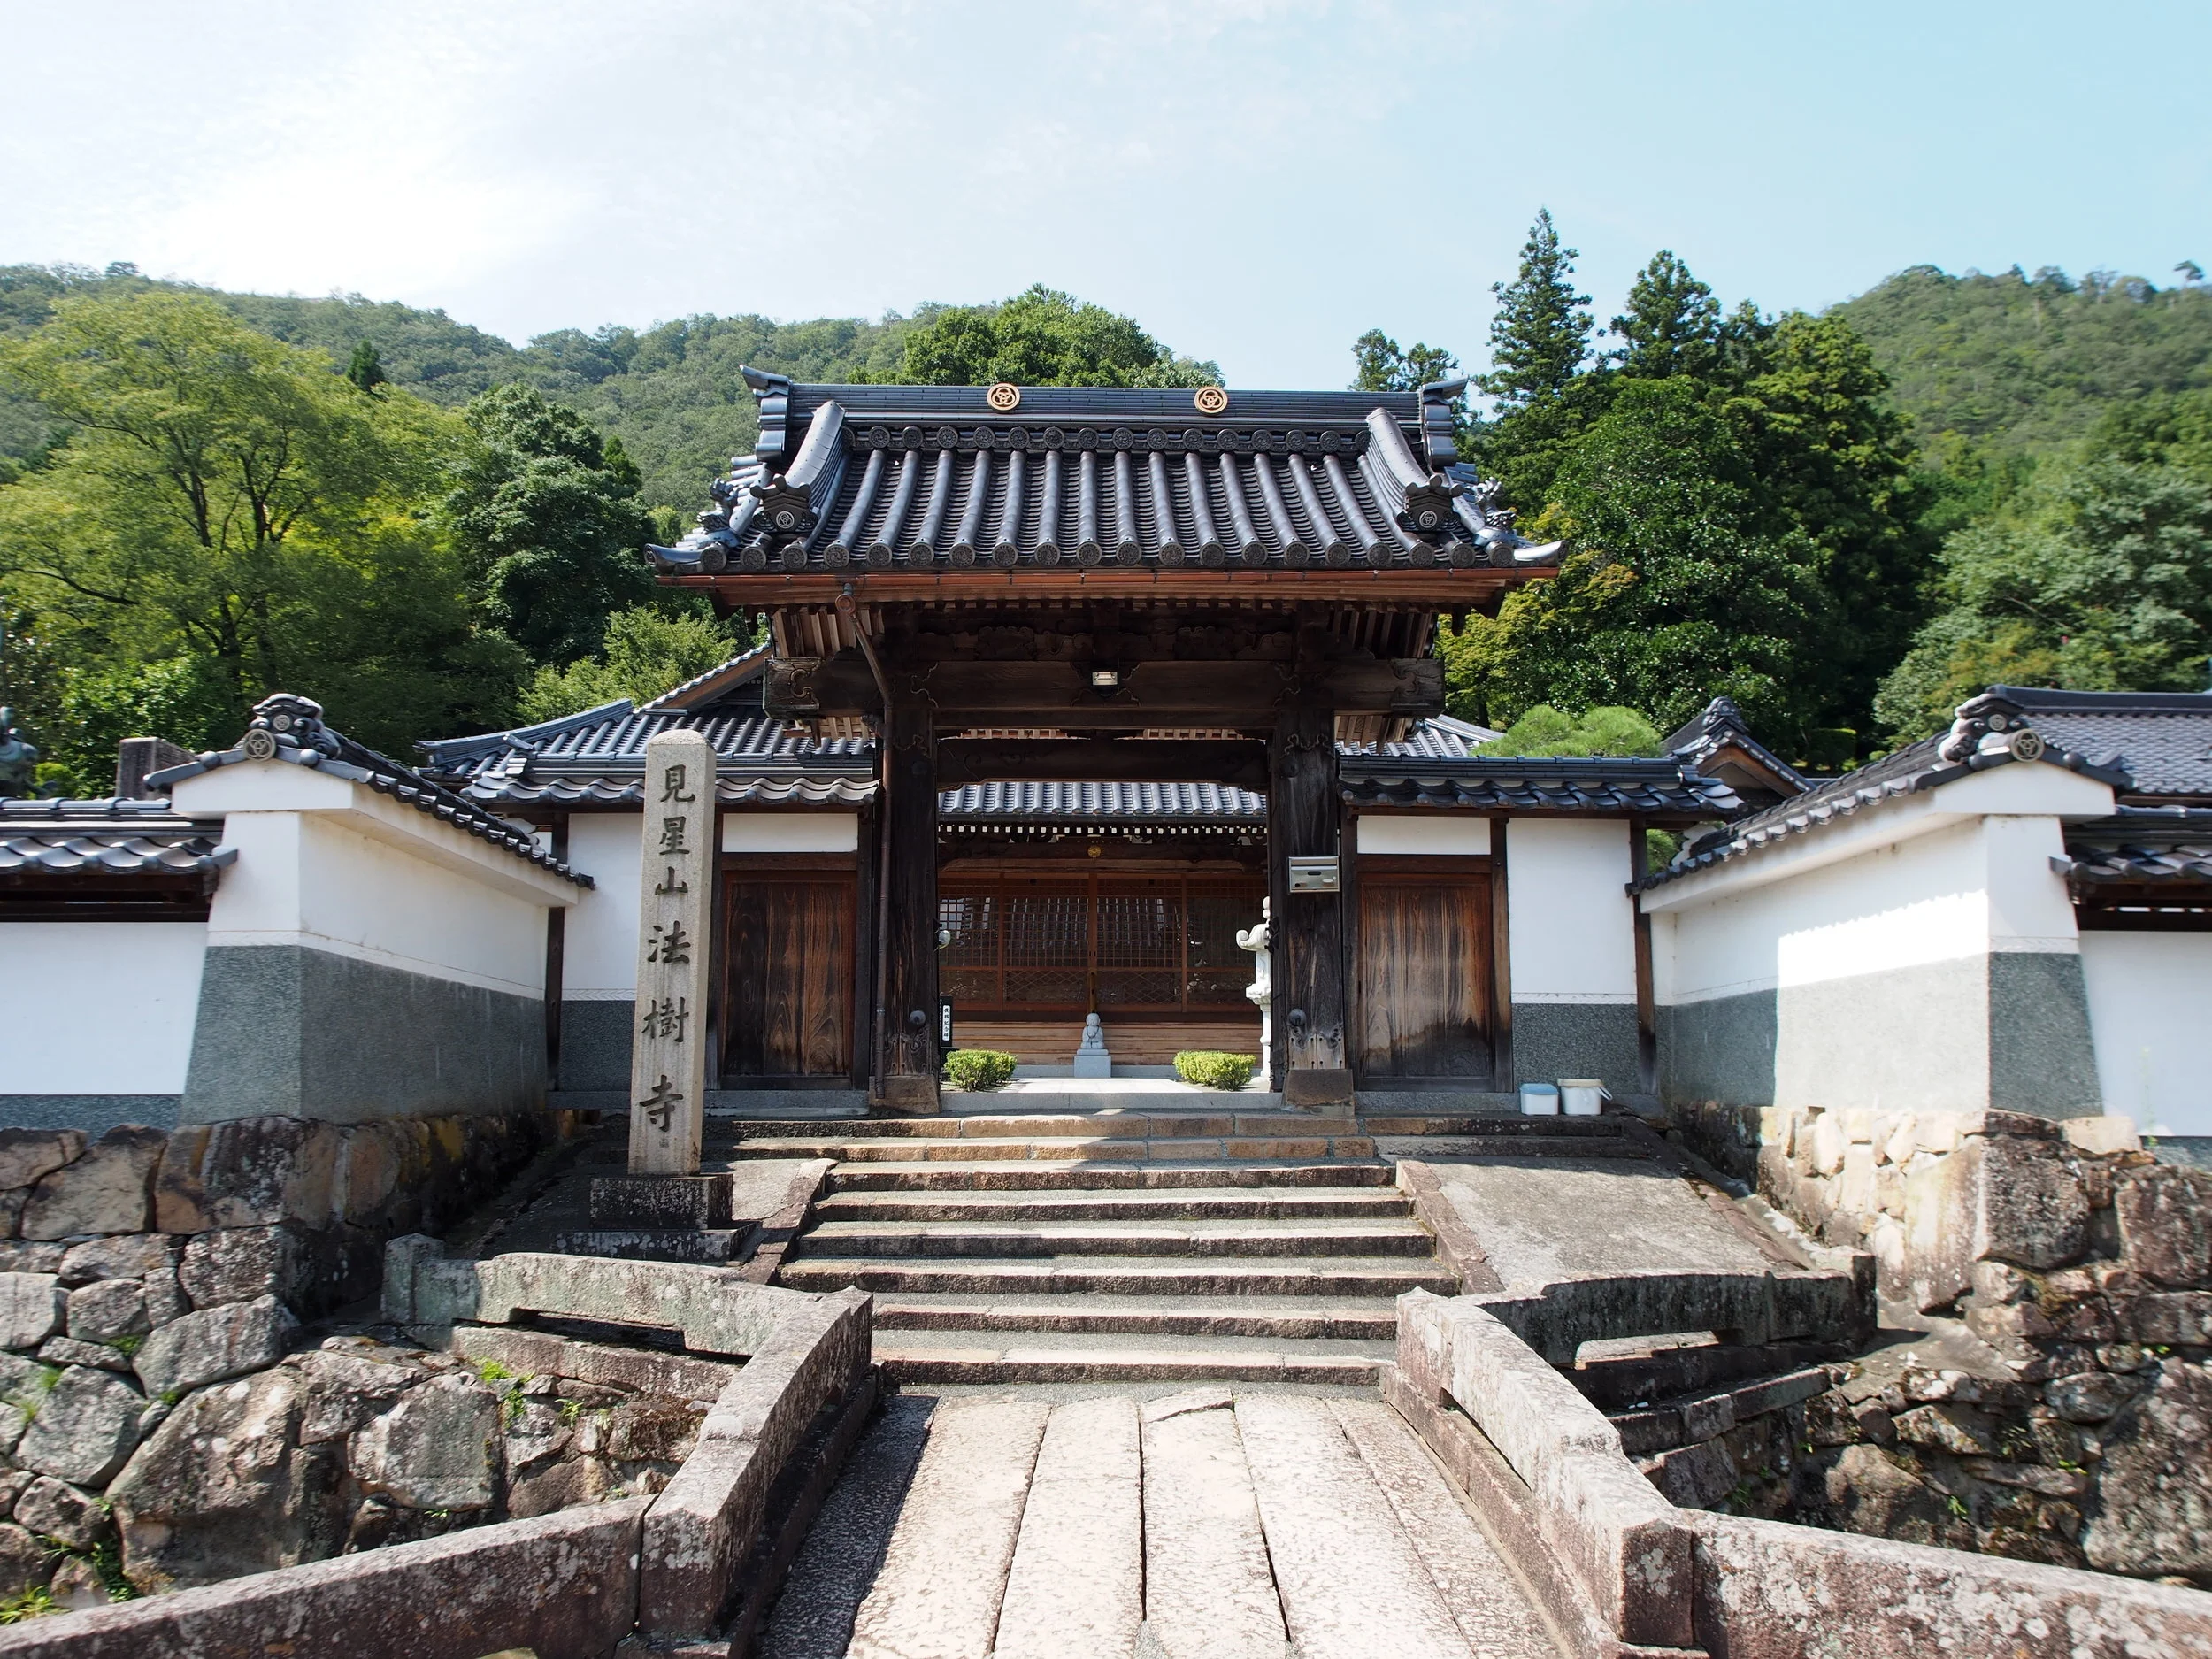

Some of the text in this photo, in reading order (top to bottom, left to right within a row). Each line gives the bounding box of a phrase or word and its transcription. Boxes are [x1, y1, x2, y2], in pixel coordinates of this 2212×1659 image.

[639, 764, 695, 1133] 見星山法樹寺
